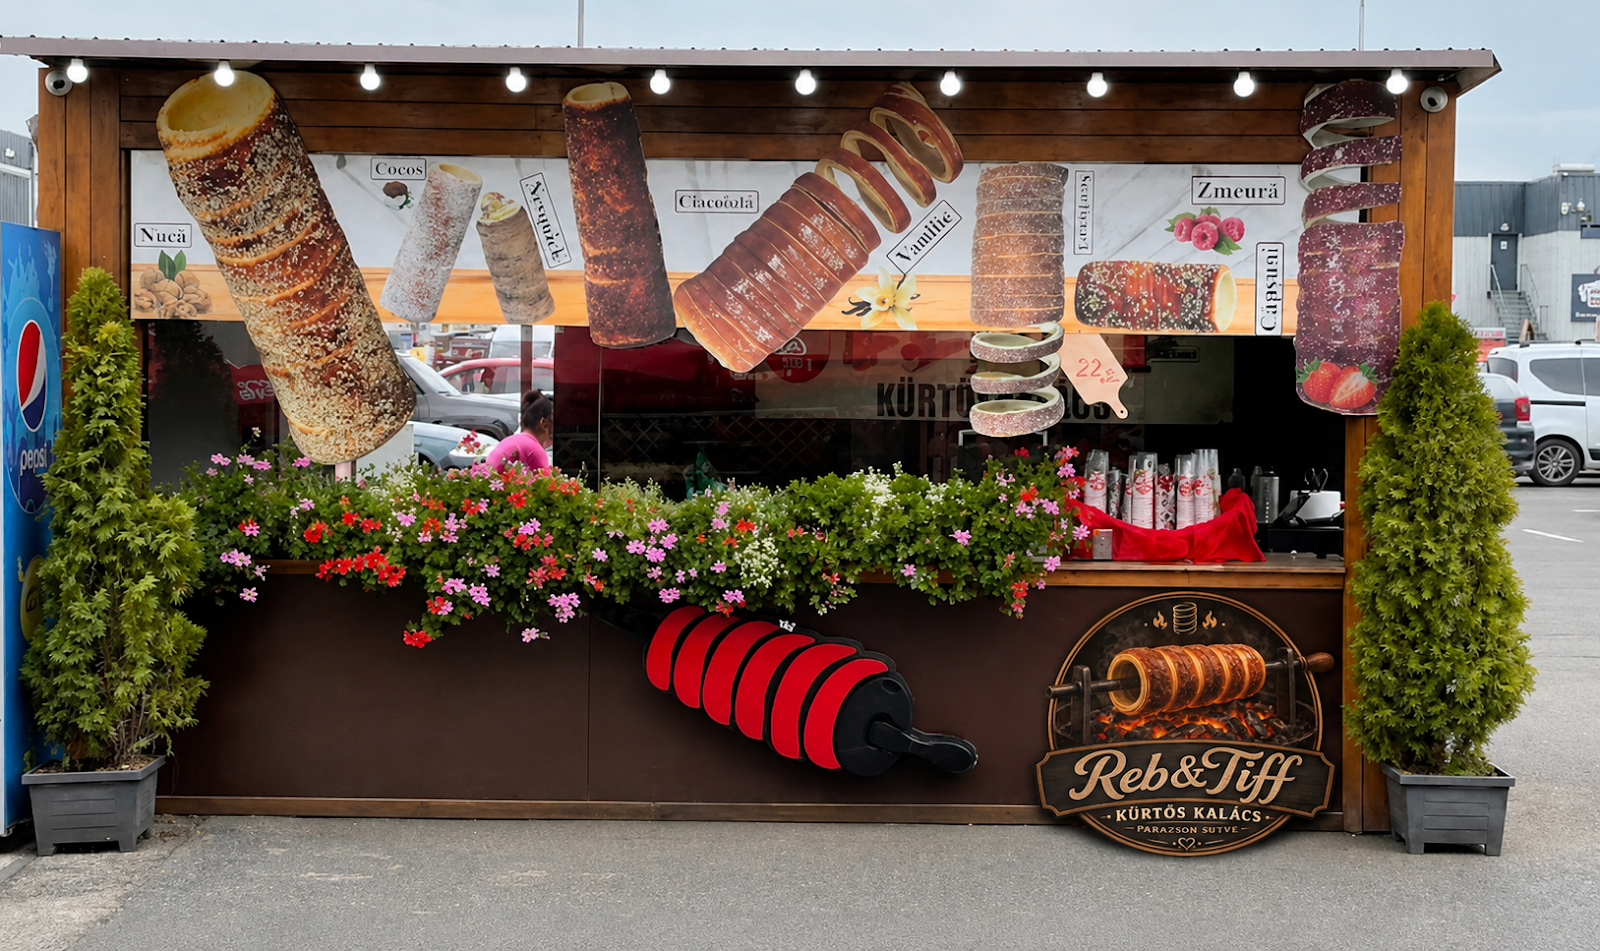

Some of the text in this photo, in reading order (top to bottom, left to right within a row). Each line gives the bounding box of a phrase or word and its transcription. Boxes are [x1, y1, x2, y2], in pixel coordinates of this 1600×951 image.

[375, 161, 423, 176] Cocos
[1197, 181, 1279, 199] Zmeură
[140, 227, 187, 243] Nucă
[1076, 357, 1102, 378] 22
[20, 442, 48, 476] pepsi
[1069, 747, 1303, 804] Reb&Tiff
[1193, 805, 1262, 823] KALÁCS
[1136, 824, 1198, 834] PARAZSON
